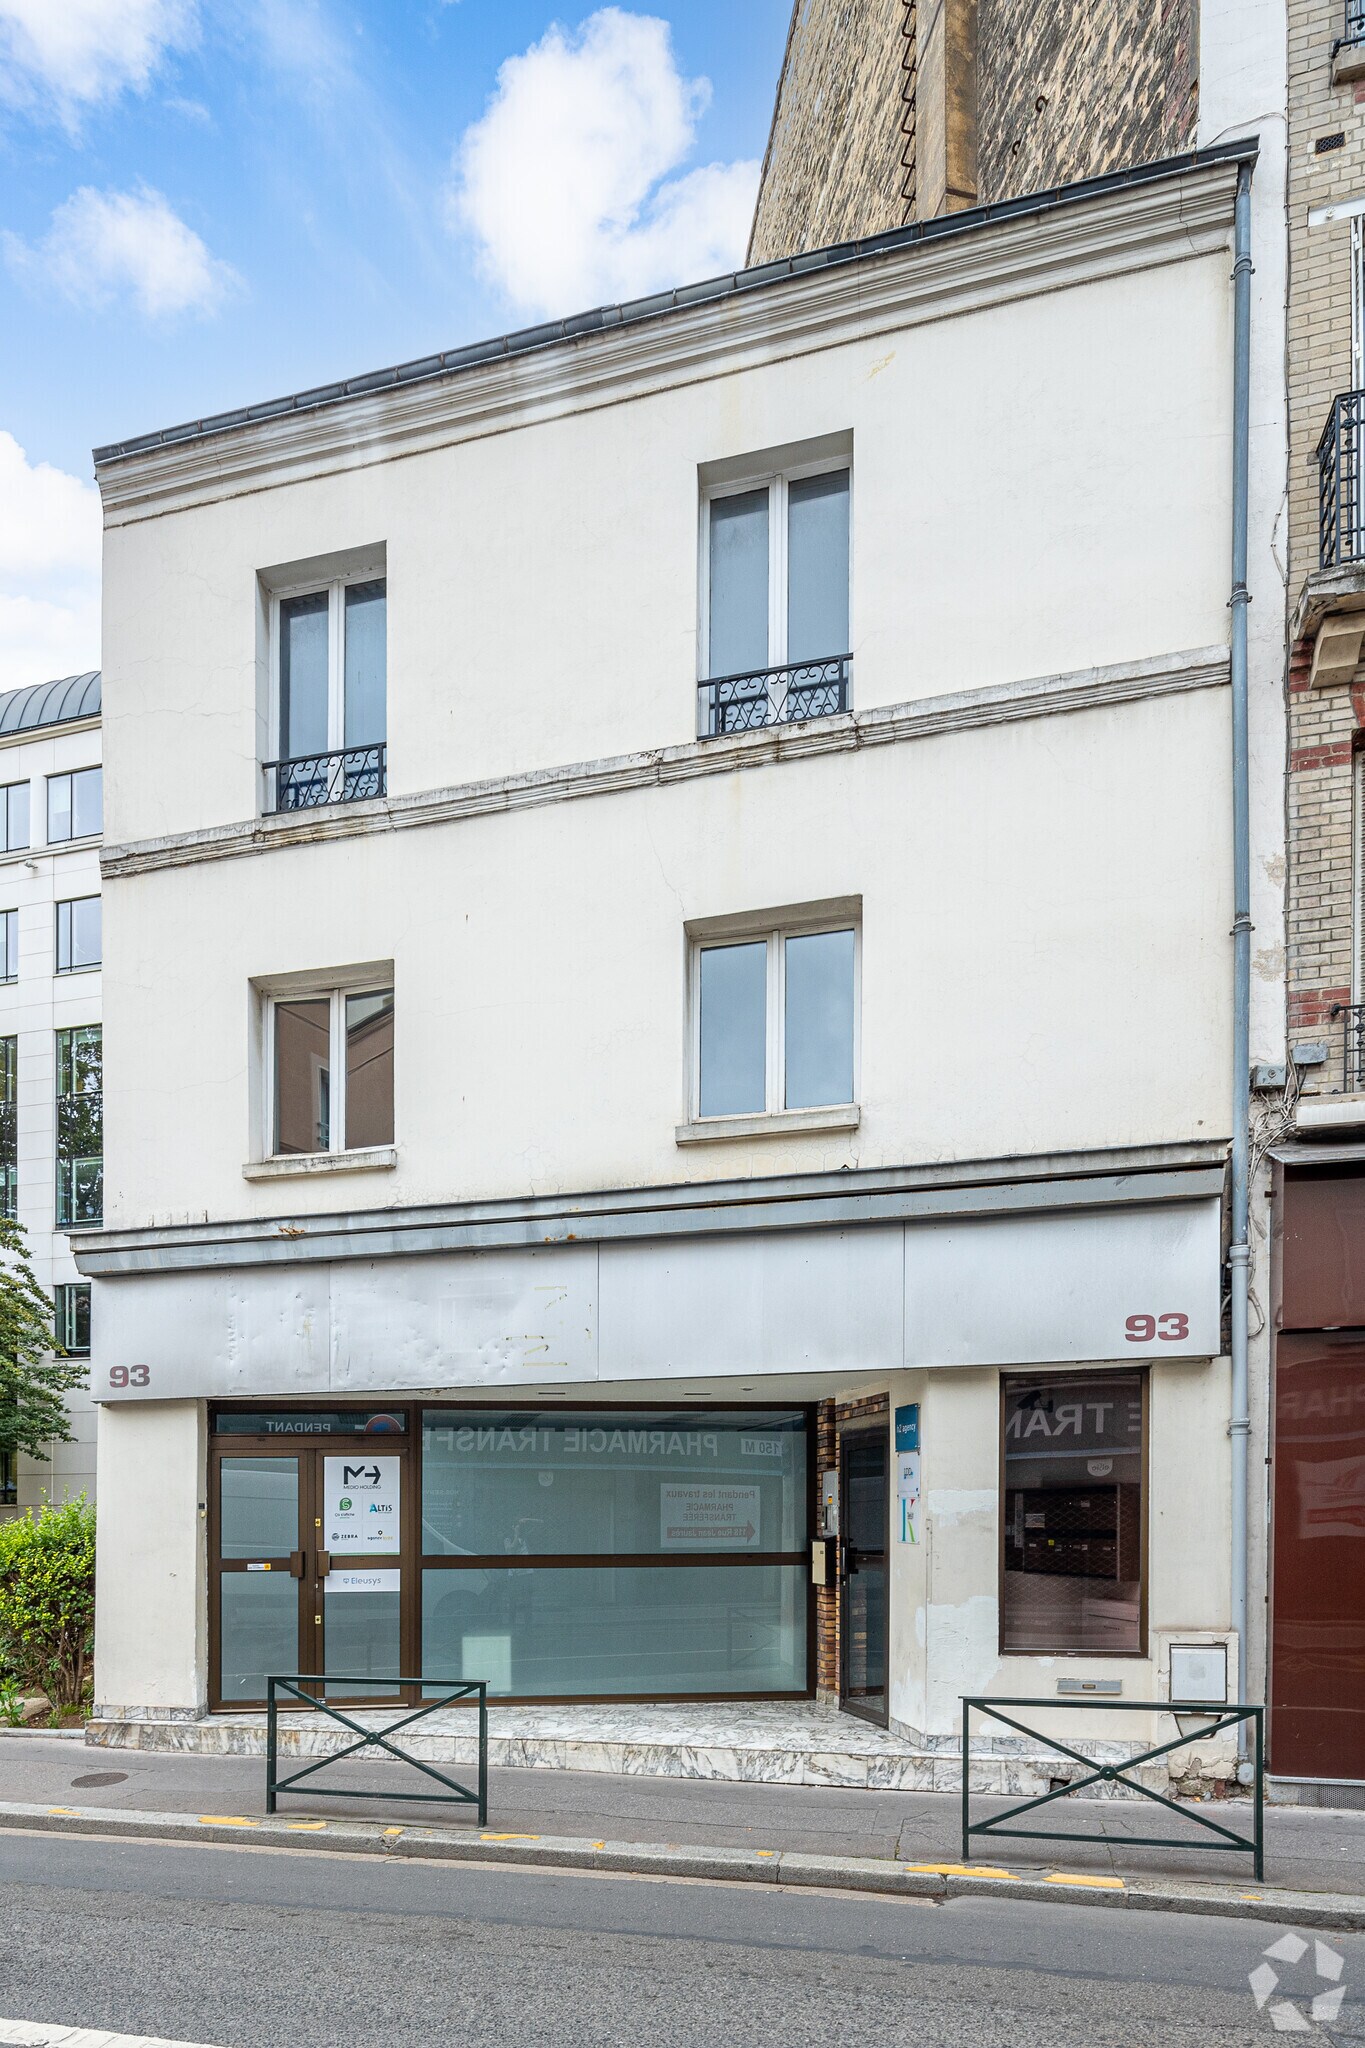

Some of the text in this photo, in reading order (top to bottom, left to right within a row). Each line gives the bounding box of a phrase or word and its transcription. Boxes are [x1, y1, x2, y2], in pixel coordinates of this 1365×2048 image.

[1124, 1312, 1189, 1342] 93
[109, 1364, 150, 1388] 93
[902, 1422, 916, 1434] agency
[351, 1577, 382, 1586] Eleusys
